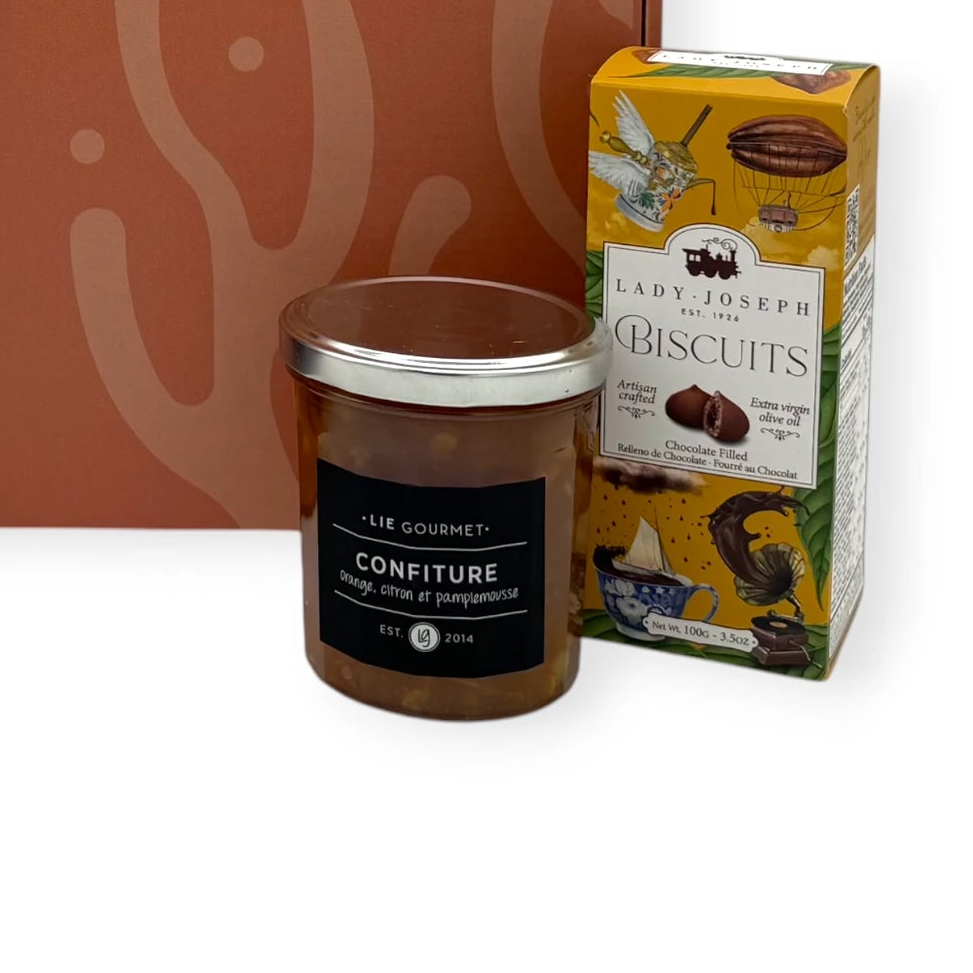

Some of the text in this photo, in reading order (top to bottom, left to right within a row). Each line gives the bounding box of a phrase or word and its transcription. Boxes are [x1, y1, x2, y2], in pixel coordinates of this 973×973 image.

[615, 278, 810, 317] LADY JOSEPH
[680, 308, 740, 323] EST. 1926
[615, 314, 809, 378] BISCUITS
[617, 379, 657, 394] Artisan
[618, 390, 656, 405] crafted
[750, 397, 811, 417] Extra virgin
[758, 412, 801, 427] olive oil
[665, 439, 748, 462] Chocolate Filled
[617, 443, 798, 480] Relleno de Chocolate Fourré au Chocolat
[370, 514, 395, 530] LIE
[355, 552, 498, 584] CONFITURE
[380, 584, 413, 601] citron
[418, 590, 432, 603] et
[436, 587, 519, 609] pamplemousse
[379, 624, 404, 638] EST.
[444, 633, 474, 644] 2014
[652, 621, 667, 630] Net
